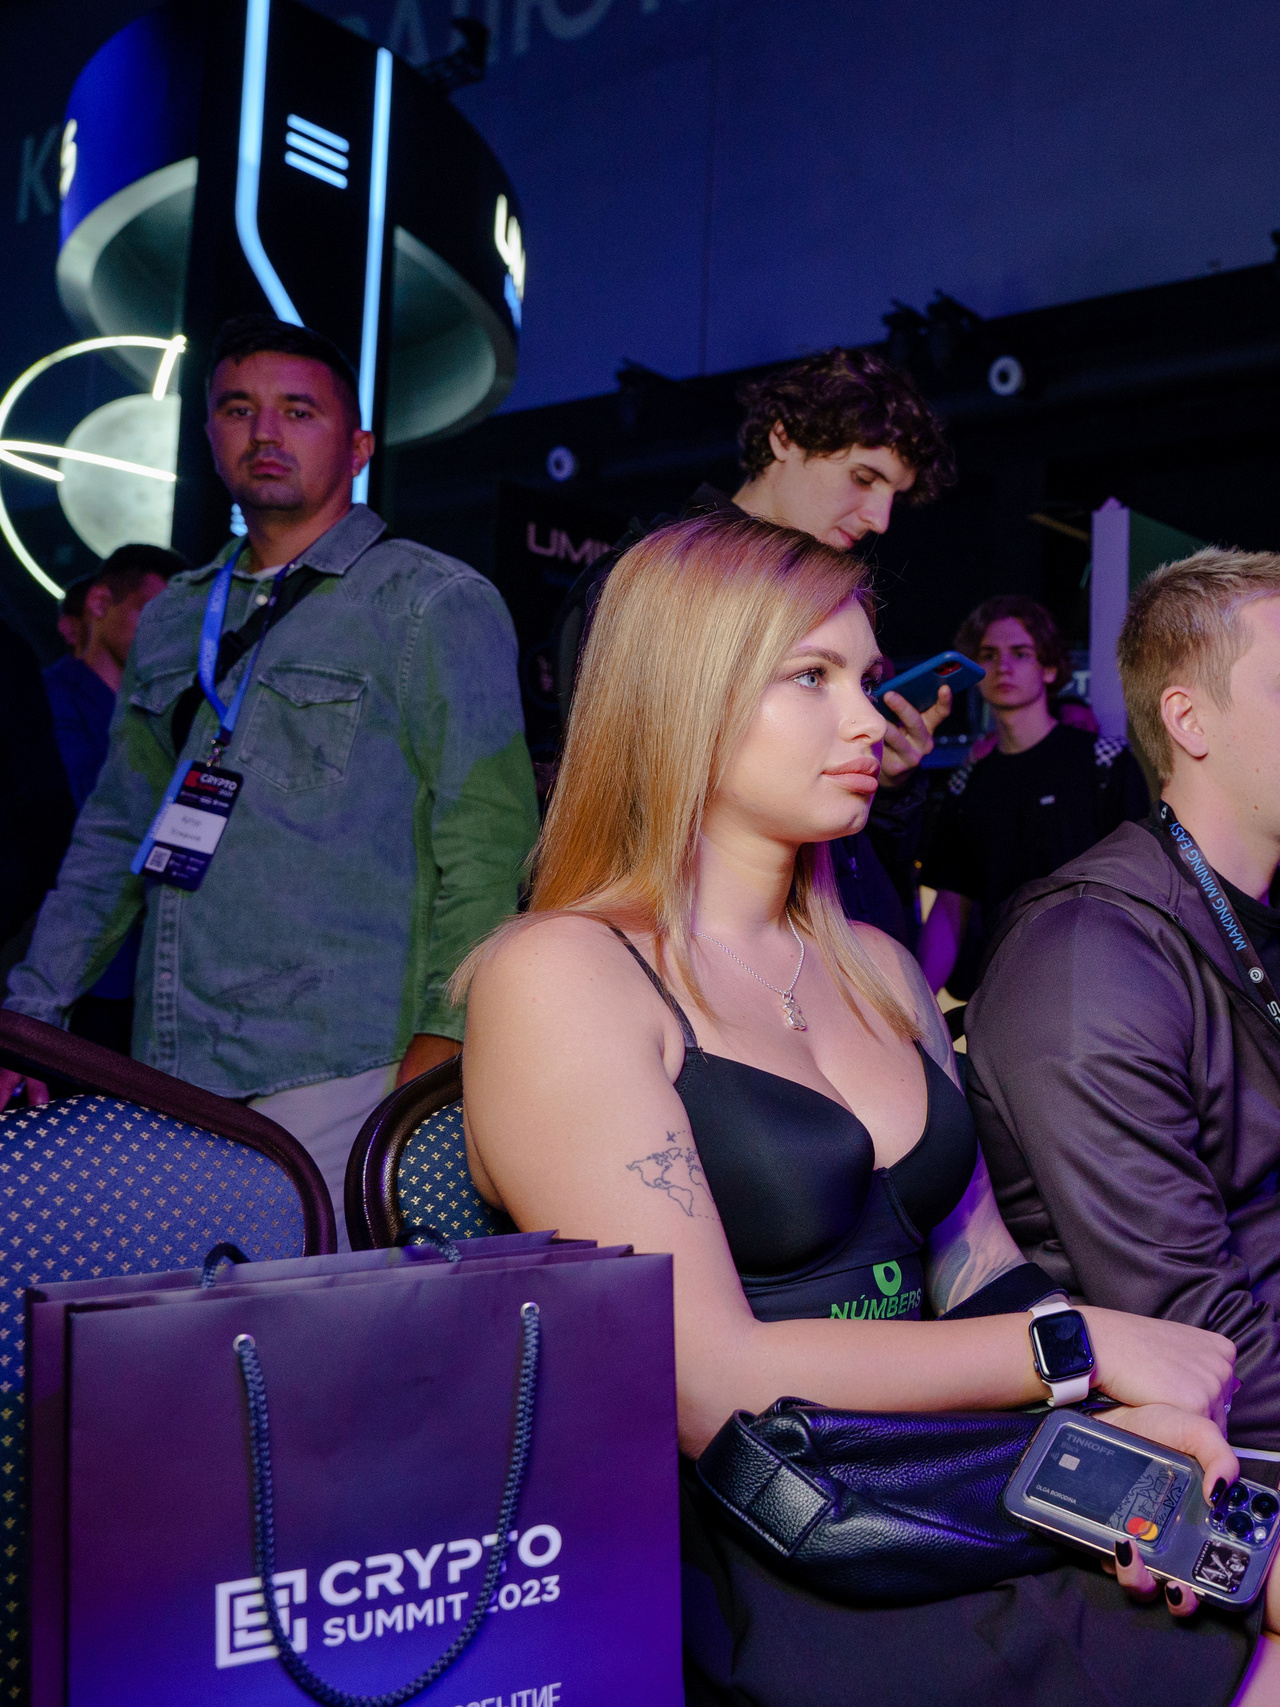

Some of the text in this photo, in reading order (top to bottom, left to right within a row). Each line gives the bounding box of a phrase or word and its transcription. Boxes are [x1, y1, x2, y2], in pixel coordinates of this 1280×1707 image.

[199, 773, 238, 791] CRYPTO
[1168, 820, 1248, 951] MAKING MINING EASY
[830, 1288, 922, 1320] NÚMBERS
[1060, 1441, 1080, 1454] Black
[1066, 1433, 1115, 1456] TINKOFF
[1036, 1484, 1077, 1504] OLGA BORODINA
[322, 1591, 469, 1647] SUMMIT
